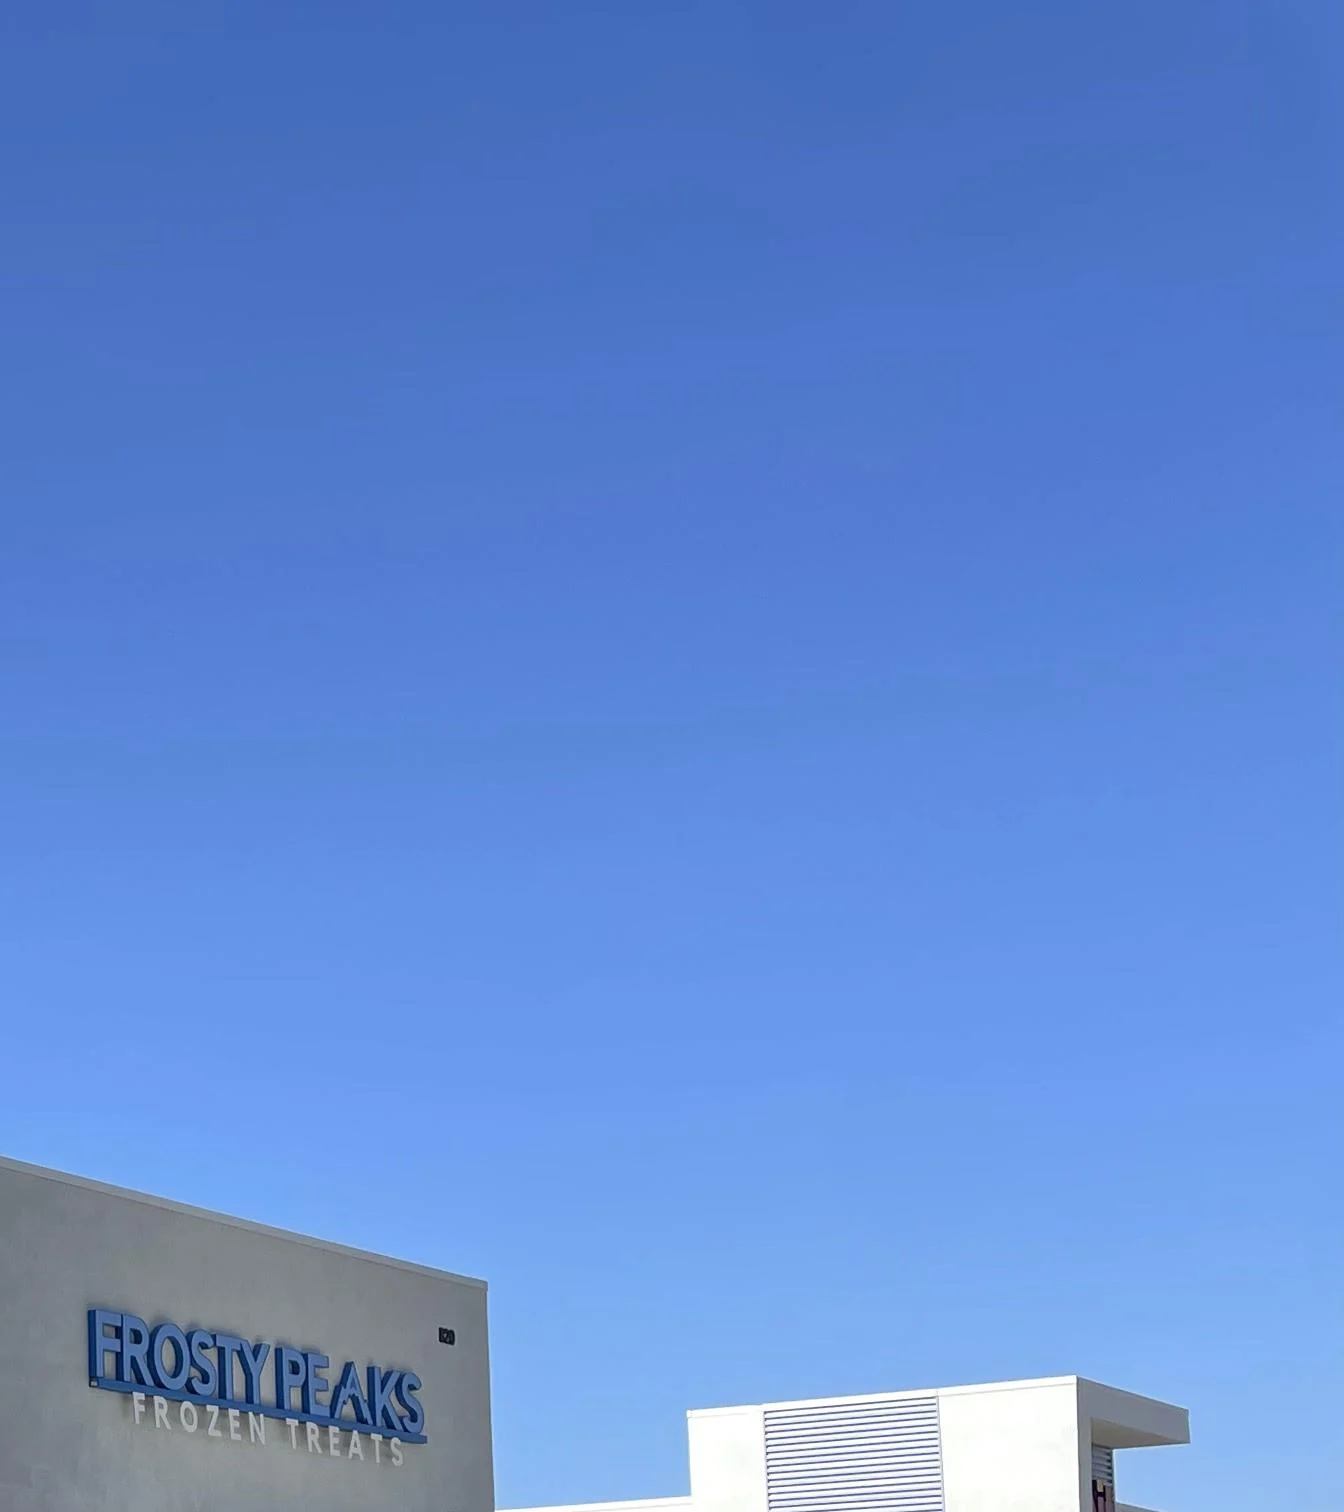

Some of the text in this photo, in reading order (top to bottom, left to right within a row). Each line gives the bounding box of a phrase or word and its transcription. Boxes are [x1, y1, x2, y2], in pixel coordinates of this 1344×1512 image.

[89, 1309, 426, 1436] FROSTY PEAKS
[133, 1391, 404, 1467] FROZEN TREATS
